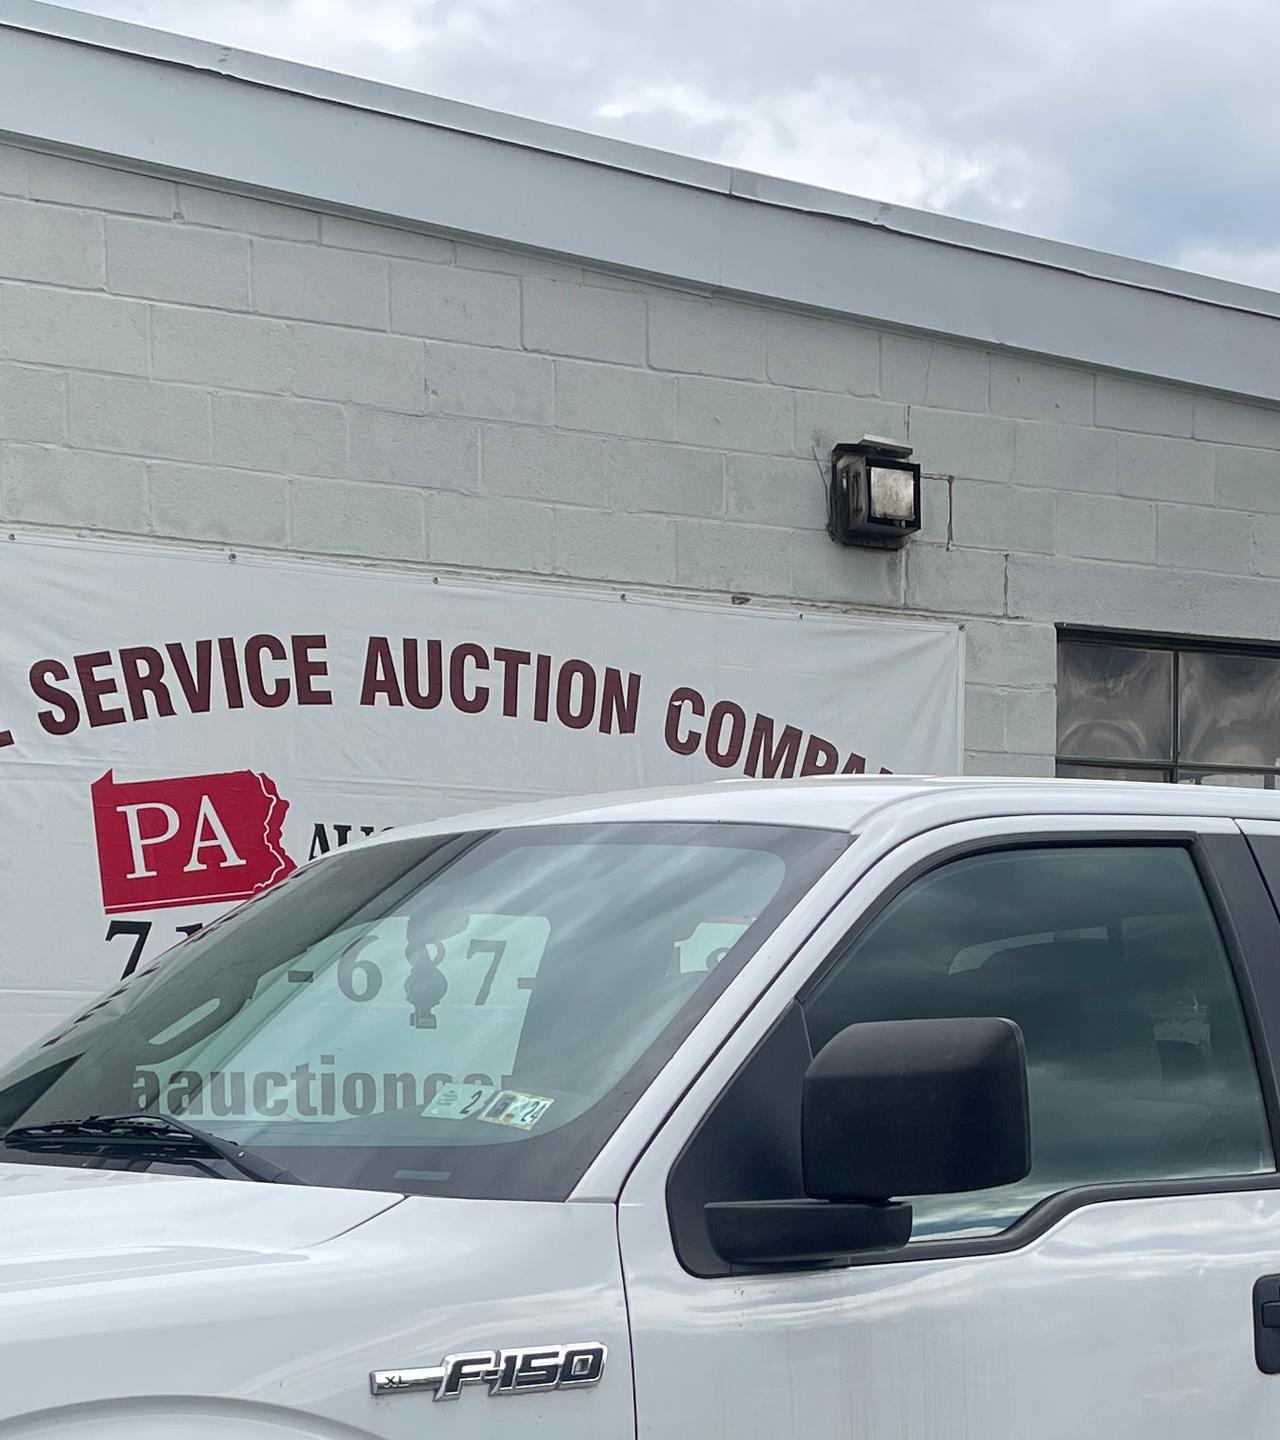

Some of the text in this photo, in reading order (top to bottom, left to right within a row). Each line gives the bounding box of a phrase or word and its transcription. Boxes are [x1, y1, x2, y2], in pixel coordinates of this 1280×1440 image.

[29, 634, 333, 736] SERVICE
[360, 636, 642, 735] AUCTION
[116, 795, 247, 880] PA
[384, 1342, 608, 1402] XL F-150
